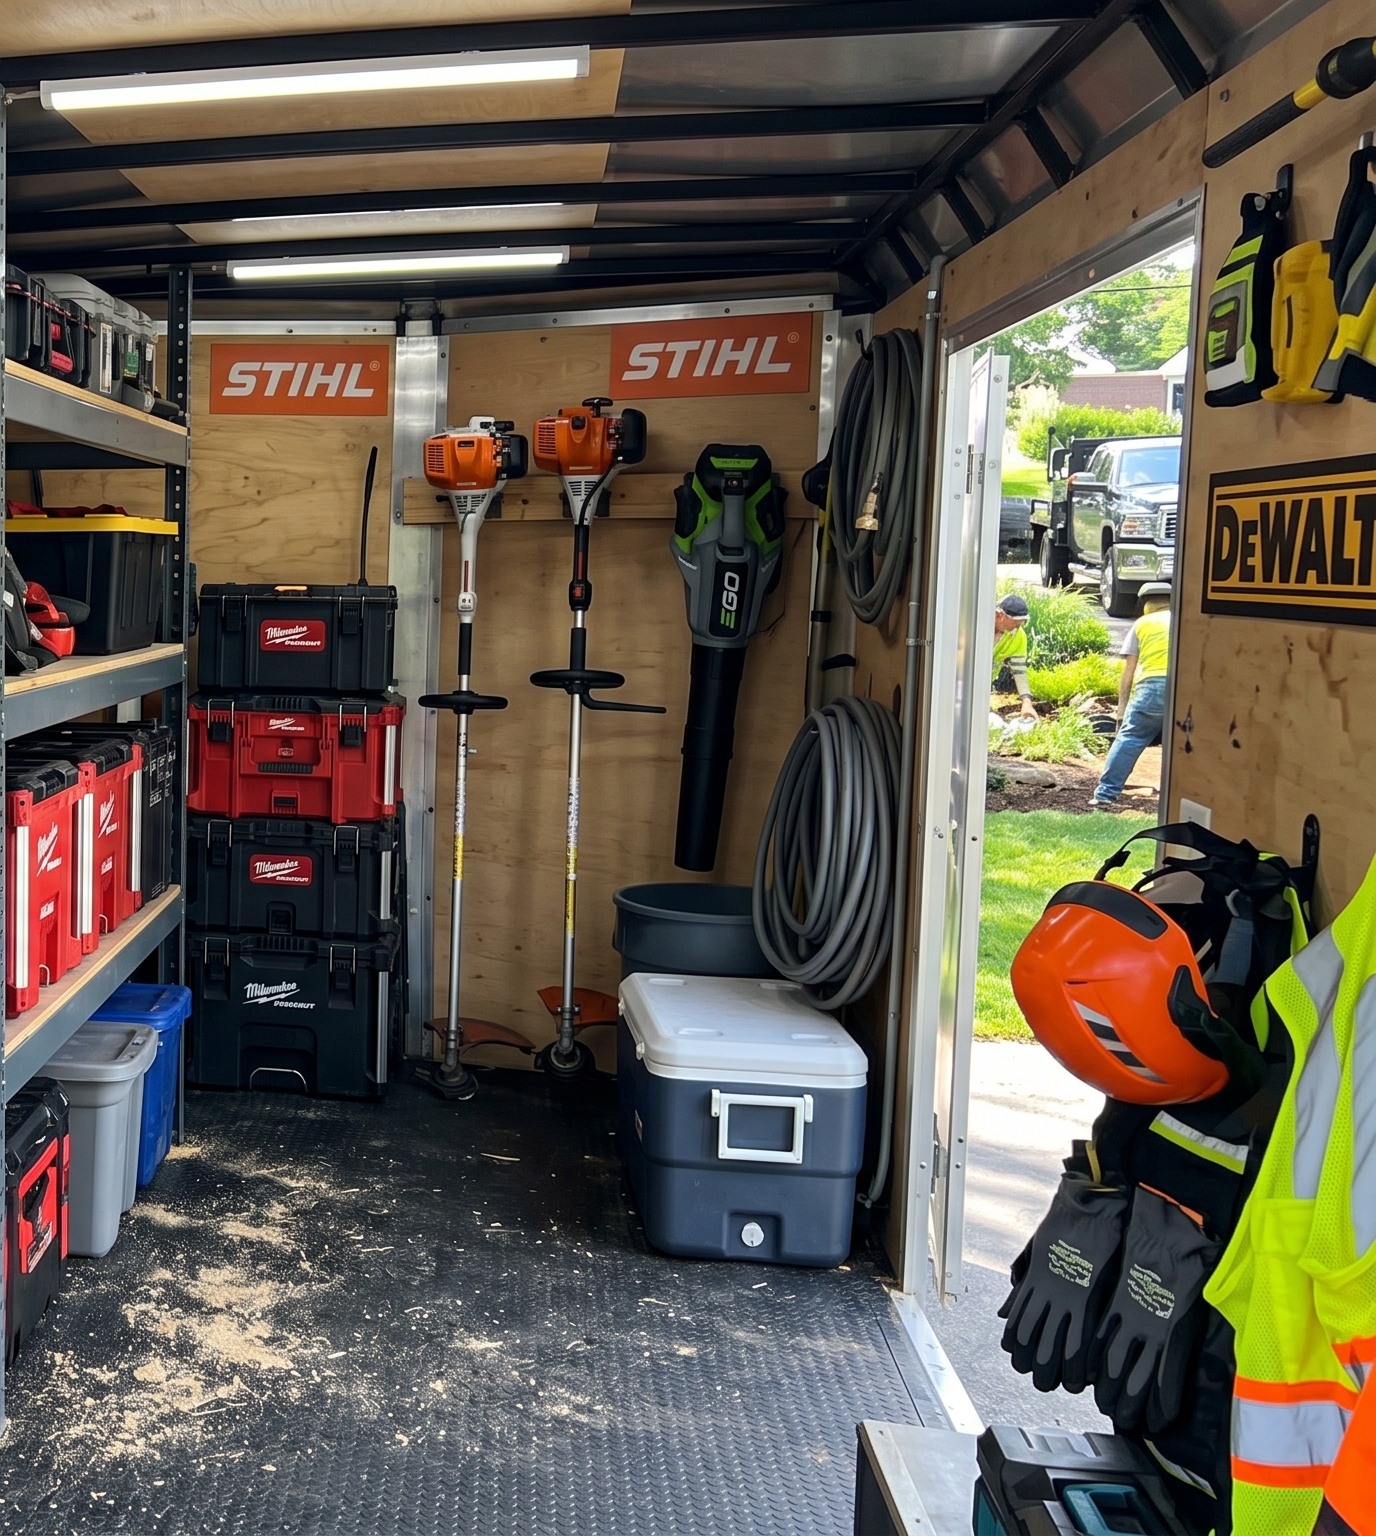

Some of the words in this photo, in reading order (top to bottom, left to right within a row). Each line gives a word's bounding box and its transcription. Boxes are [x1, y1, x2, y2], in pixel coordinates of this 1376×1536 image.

[221, 361, 375, 398] STIHL
[621, 335, 792, 381] STIHL
[720, 571, 740, 629] EGO
